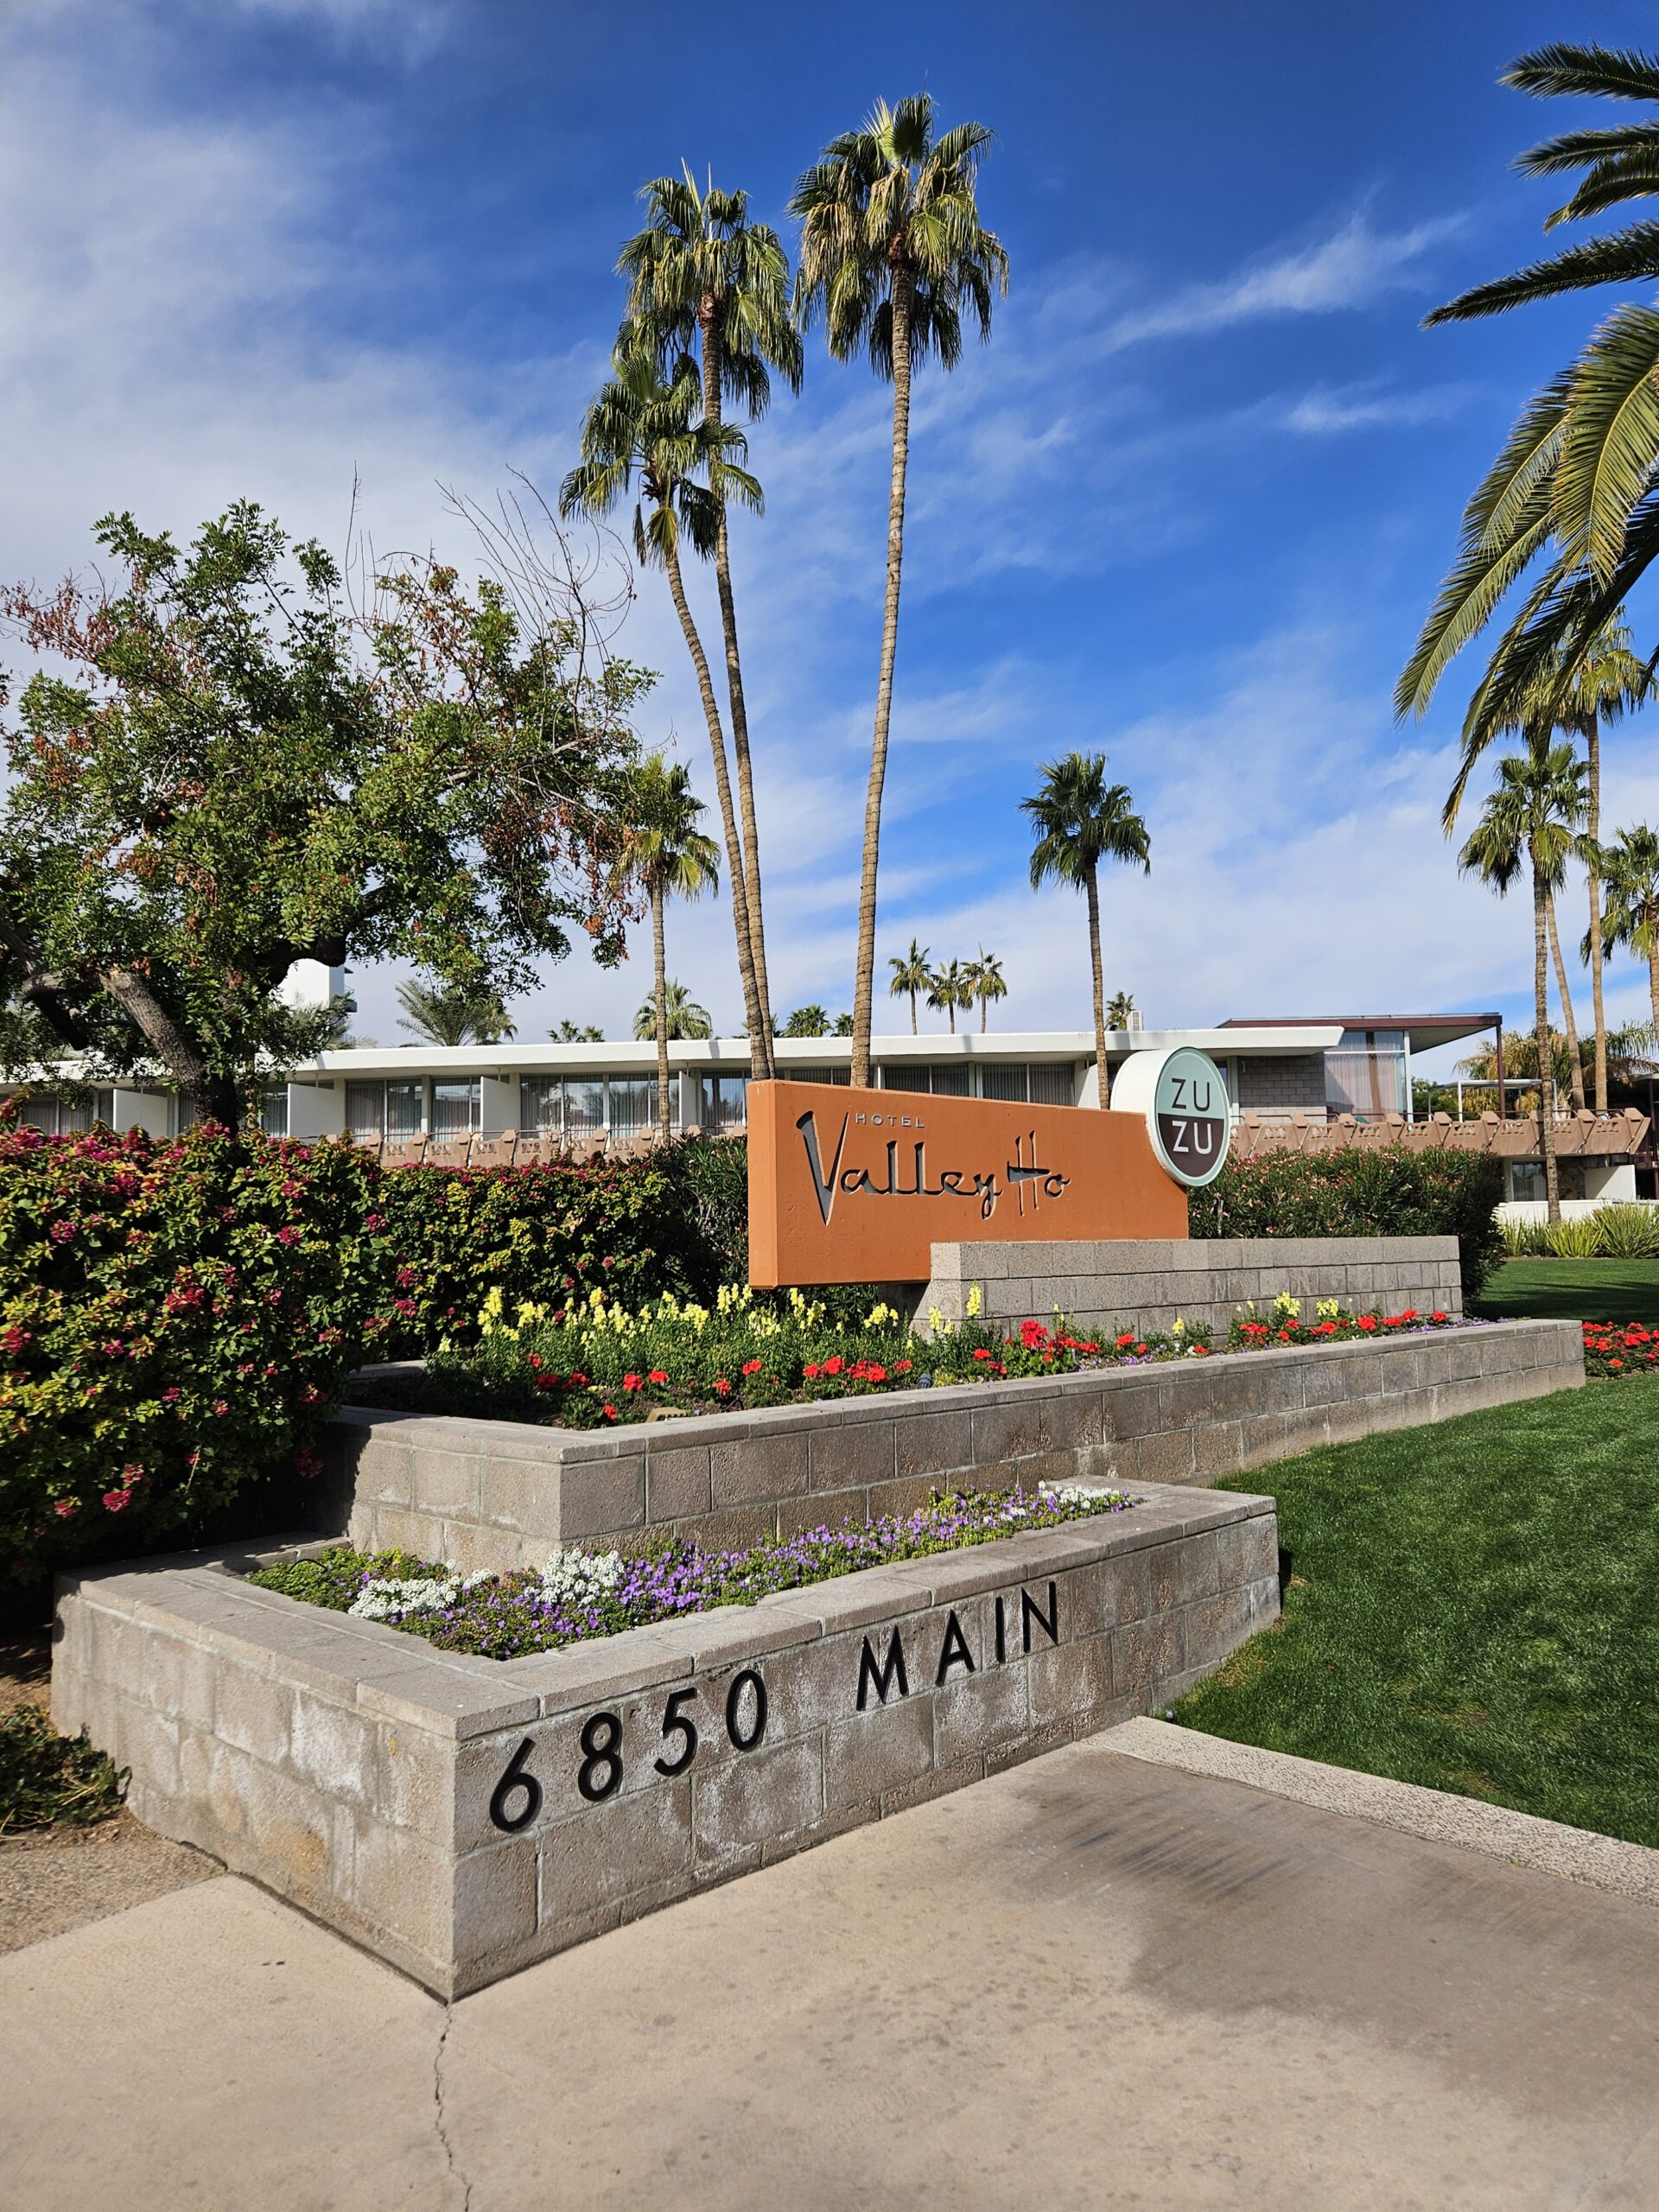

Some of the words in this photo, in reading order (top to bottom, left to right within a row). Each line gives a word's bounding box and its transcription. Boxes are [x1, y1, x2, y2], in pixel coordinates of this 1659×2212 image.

[1171, 1077, 1211, 1113] ZU
[855, 1112, 925, 1128] HOTEL
[1172, 1119, 1213, 1155] ZU
[795, 1110, 1003, 1227] Valley
[1007, 1129, 1071, 1217] Ho
[489, 1669, 768, 1834] 6850
[855, 1581, 1059, 1712] MAIN
